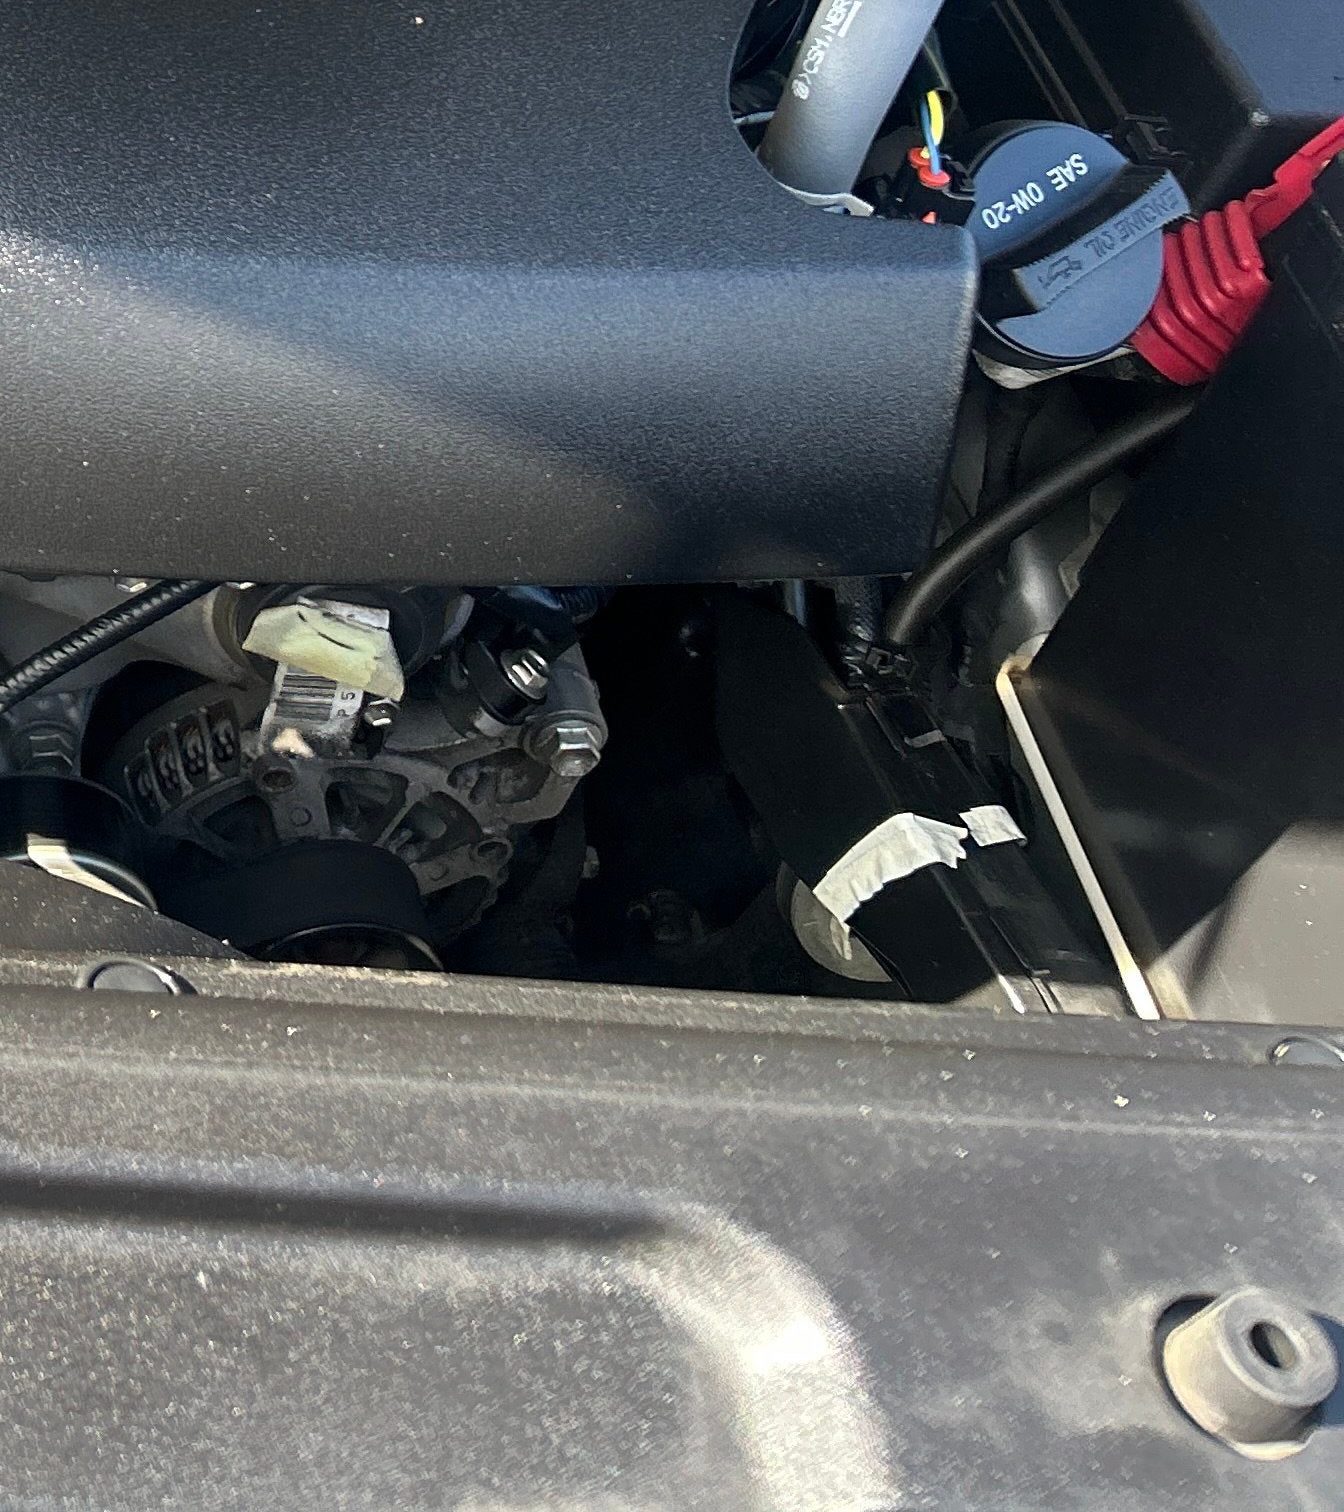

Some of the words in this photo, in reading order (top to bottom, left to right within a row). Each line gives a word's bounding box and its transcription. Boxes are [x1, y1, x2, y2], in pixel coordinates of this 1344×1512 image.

[1045, 153, 1089, 191] SAE
[981, 182, 1045, 229] 0W-20
[1113, 187, 1181, 242] ENGINE
[1083, 231, 1116, 257] OIL
